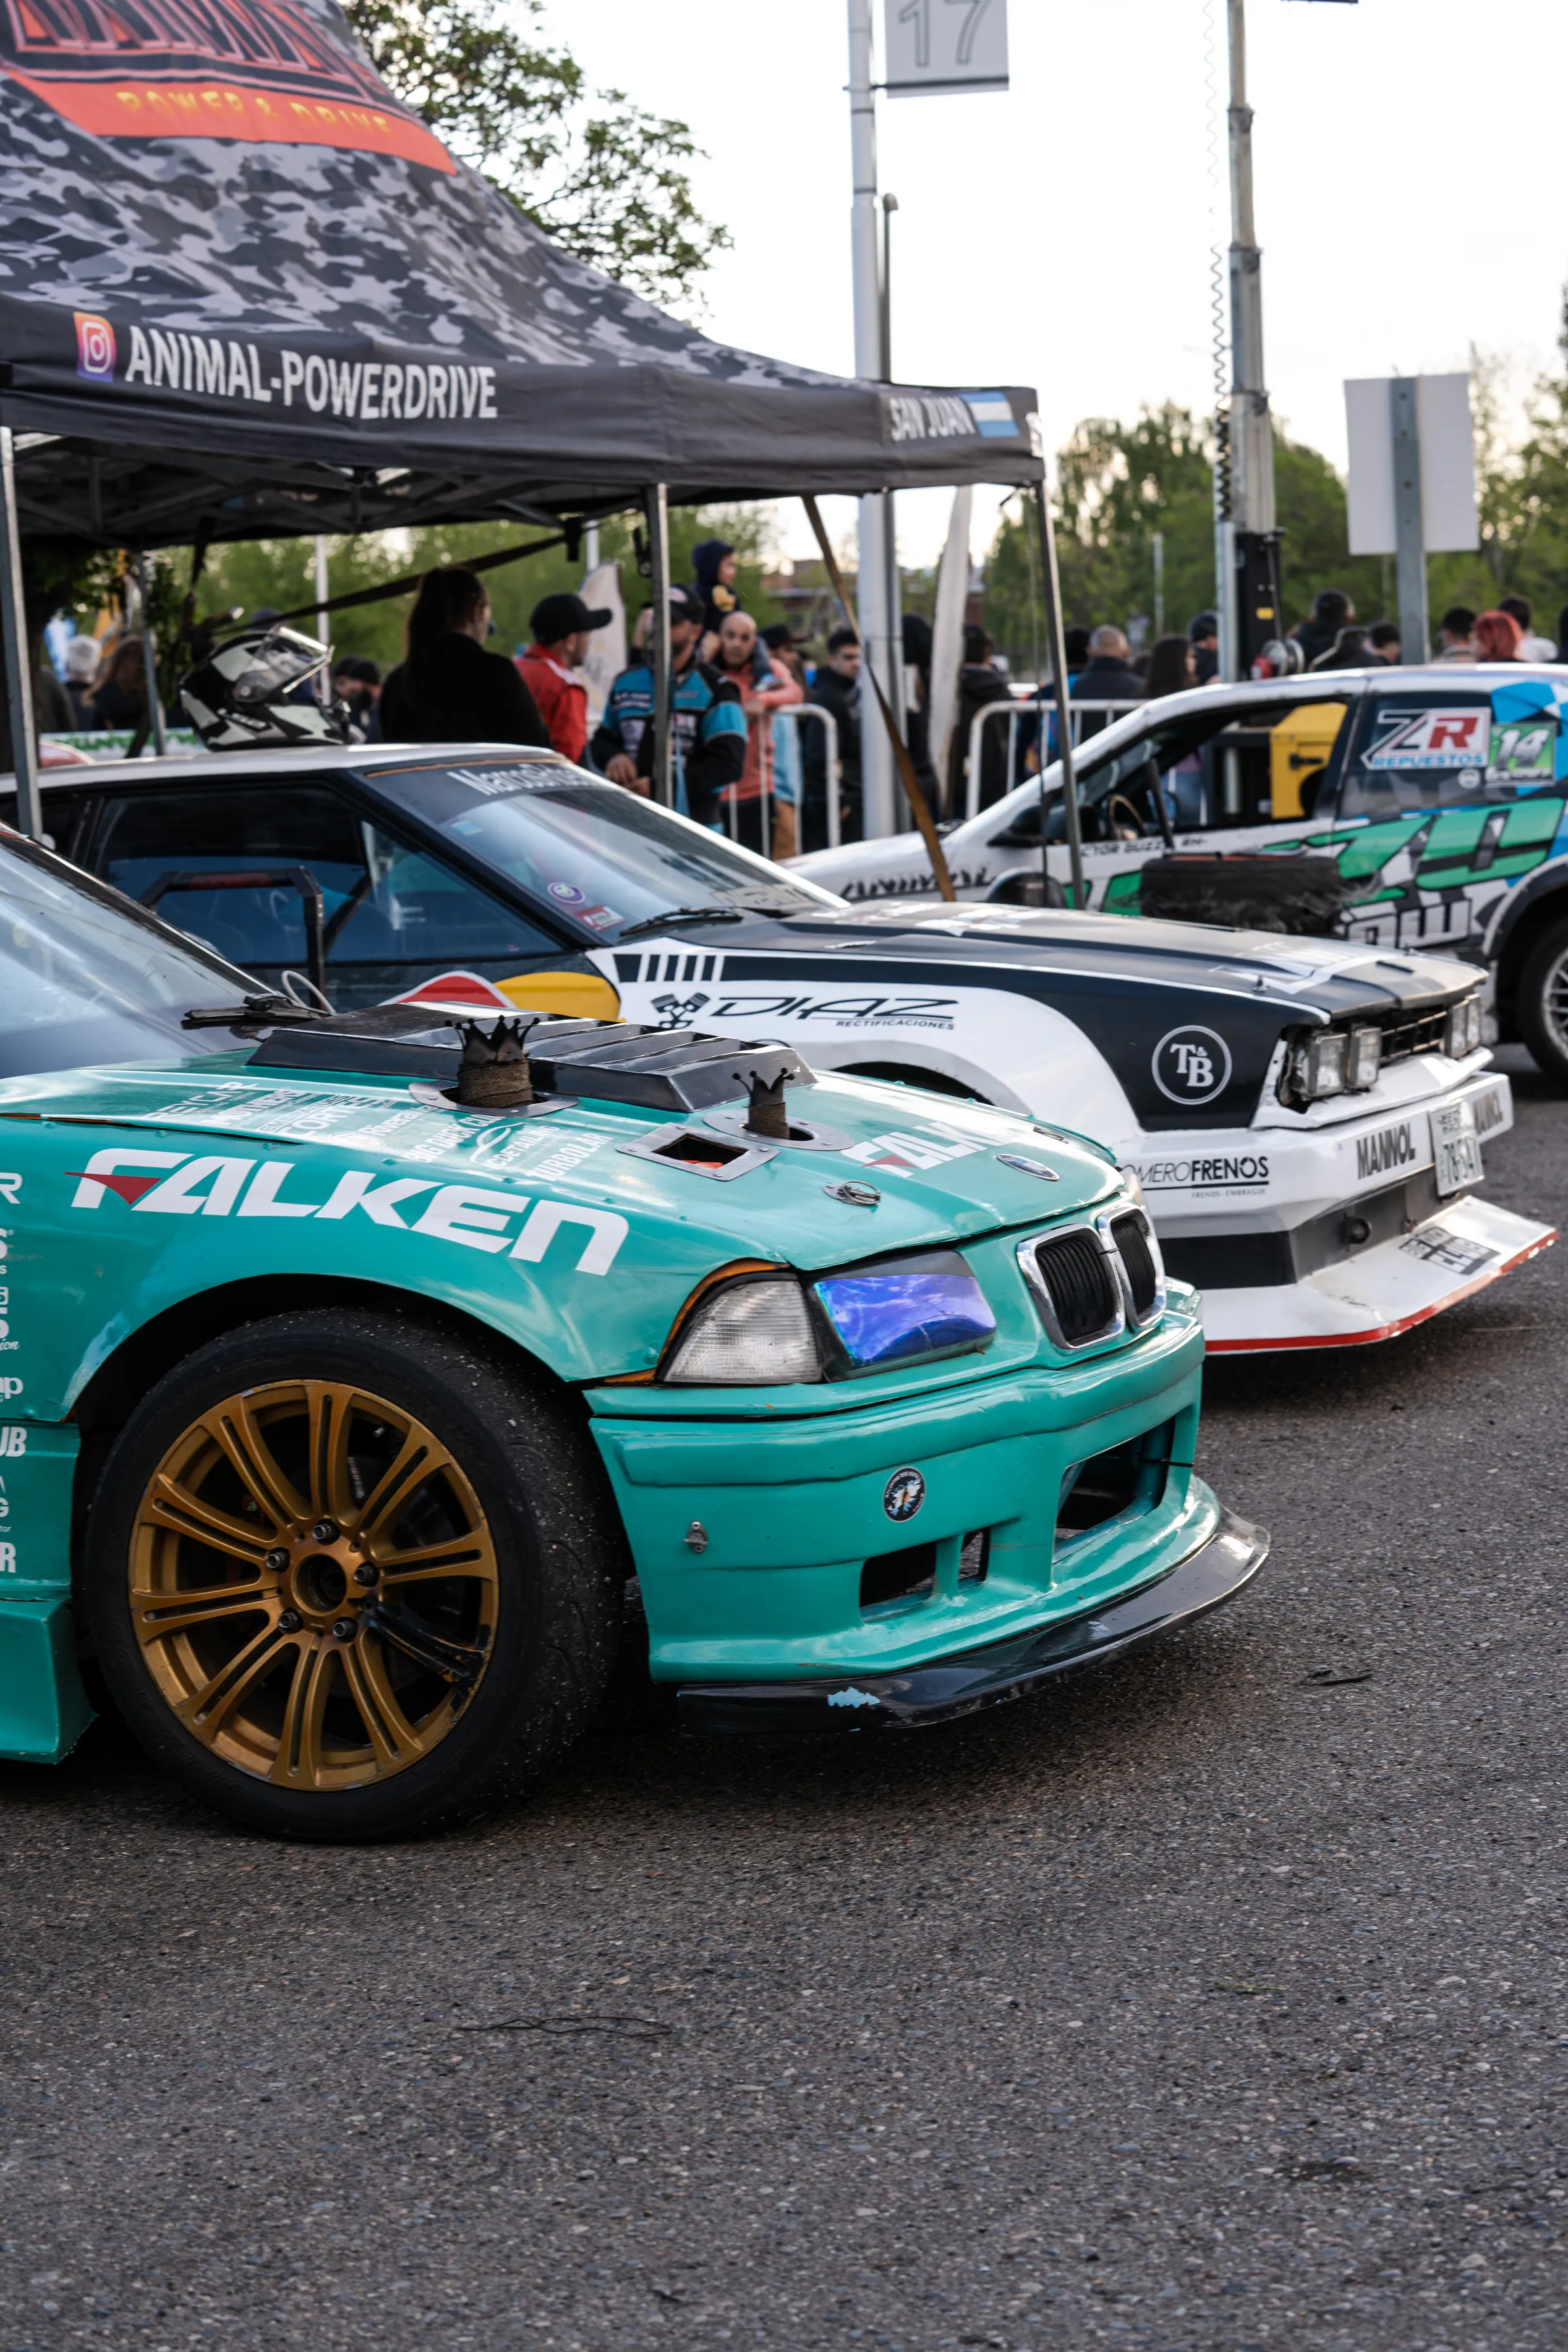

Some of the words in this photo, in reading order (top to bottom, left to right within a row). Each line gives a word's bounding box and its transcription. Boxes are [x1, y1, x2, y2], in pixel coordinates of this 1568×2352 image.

[899, 0, 996, 67] 17
[125, 325, 498, 420] ANIMAL-POWERDRIVE
[889, 396, 926, 442] SAN
[921, 396, 975, 438] JUAN
[1373, 754, 1483, 767] REPUESTOS
[1495, 729, 1550, 770] 14
[710, 998, 958, 1019] DIAZ
[836, 1021, 955, 1030] RECTIFICACIONES
[145, 1081, 259, 1119] REYCAR
[402, 1144, 446, 1164] BIG
[424, 1121, 481, 1149] DUCK
[457, 1113, 507, 1128] CLU
[525, 1133, 614, 1182] TURBOLAR
[1356, 1122, 1416, 1180] MANNOL
